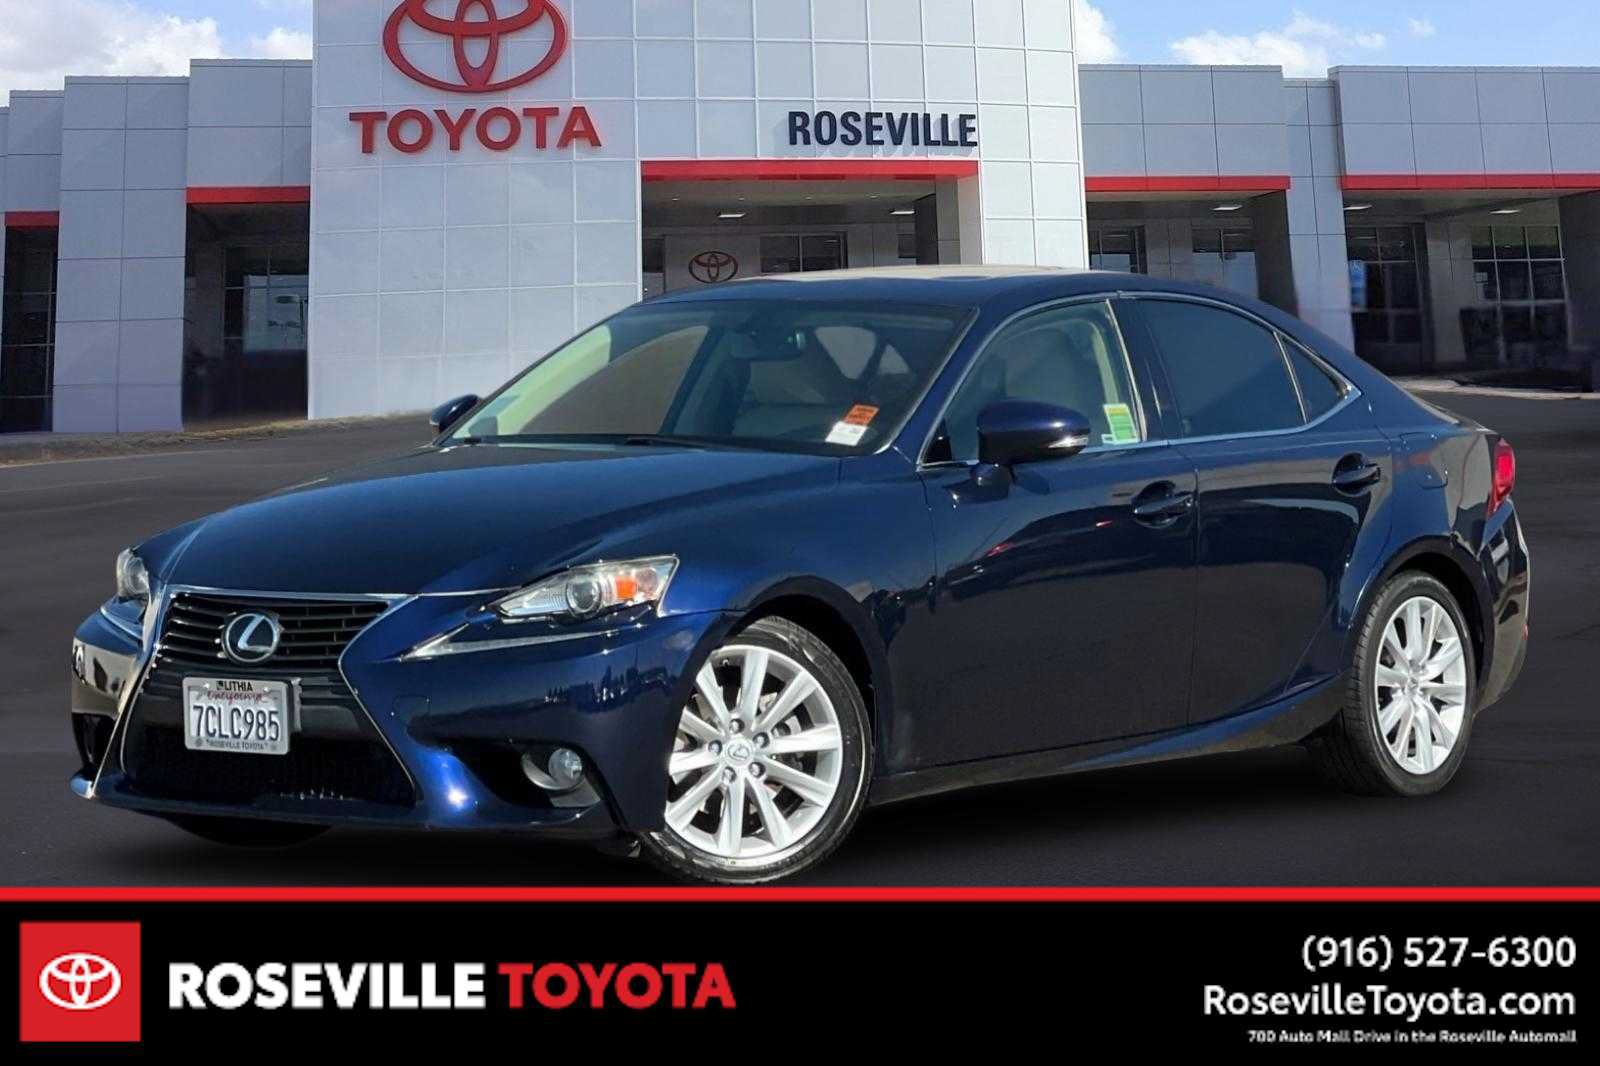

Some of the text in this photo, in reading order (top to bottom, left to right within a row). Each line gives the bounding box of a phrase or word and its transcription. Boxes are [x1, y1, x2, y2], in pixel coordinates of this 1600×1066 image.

[349, 105, 603, 154] TOYOTA
[788, 110, 979, 148] ROSEVILLE
[224, 681, 253, 691] LITHIA
[193, 705, 279, 741] 7CLC985
